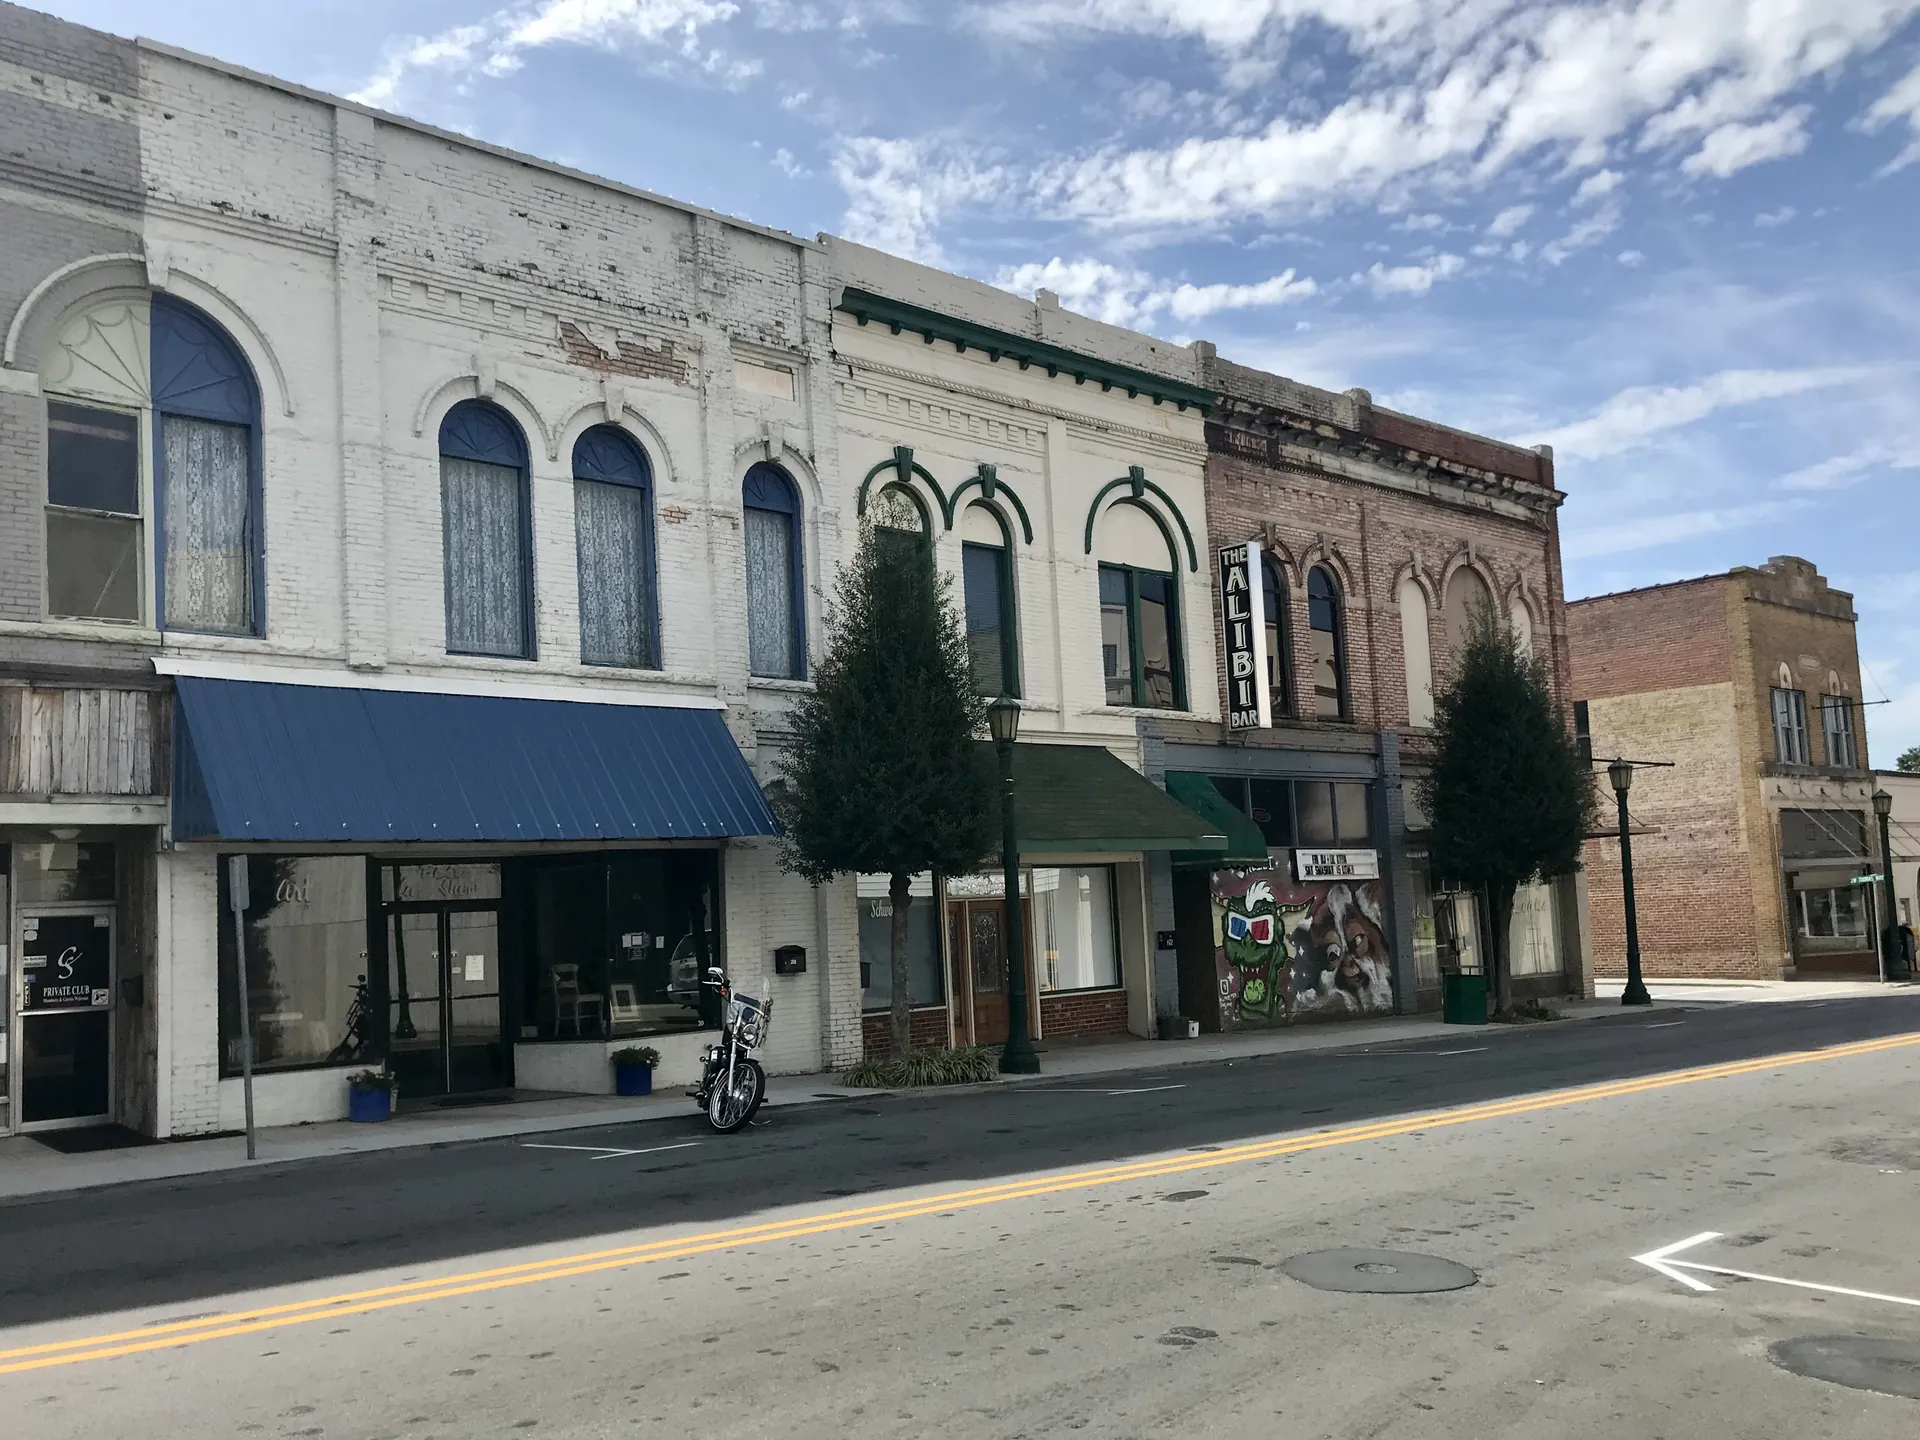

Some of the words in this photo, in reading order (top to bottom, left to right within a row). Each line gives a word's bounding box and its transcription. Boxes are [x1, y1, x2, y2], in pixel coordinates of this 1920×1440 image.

[1221, 547, 1248, 566] THE
[1225, 566, 1255, 707] ALIBI
[1231, 709, 1259, 728] BAR
[43, 986, 71, 997] PRIVATE
[71, 984, 90, 995] CLUB
